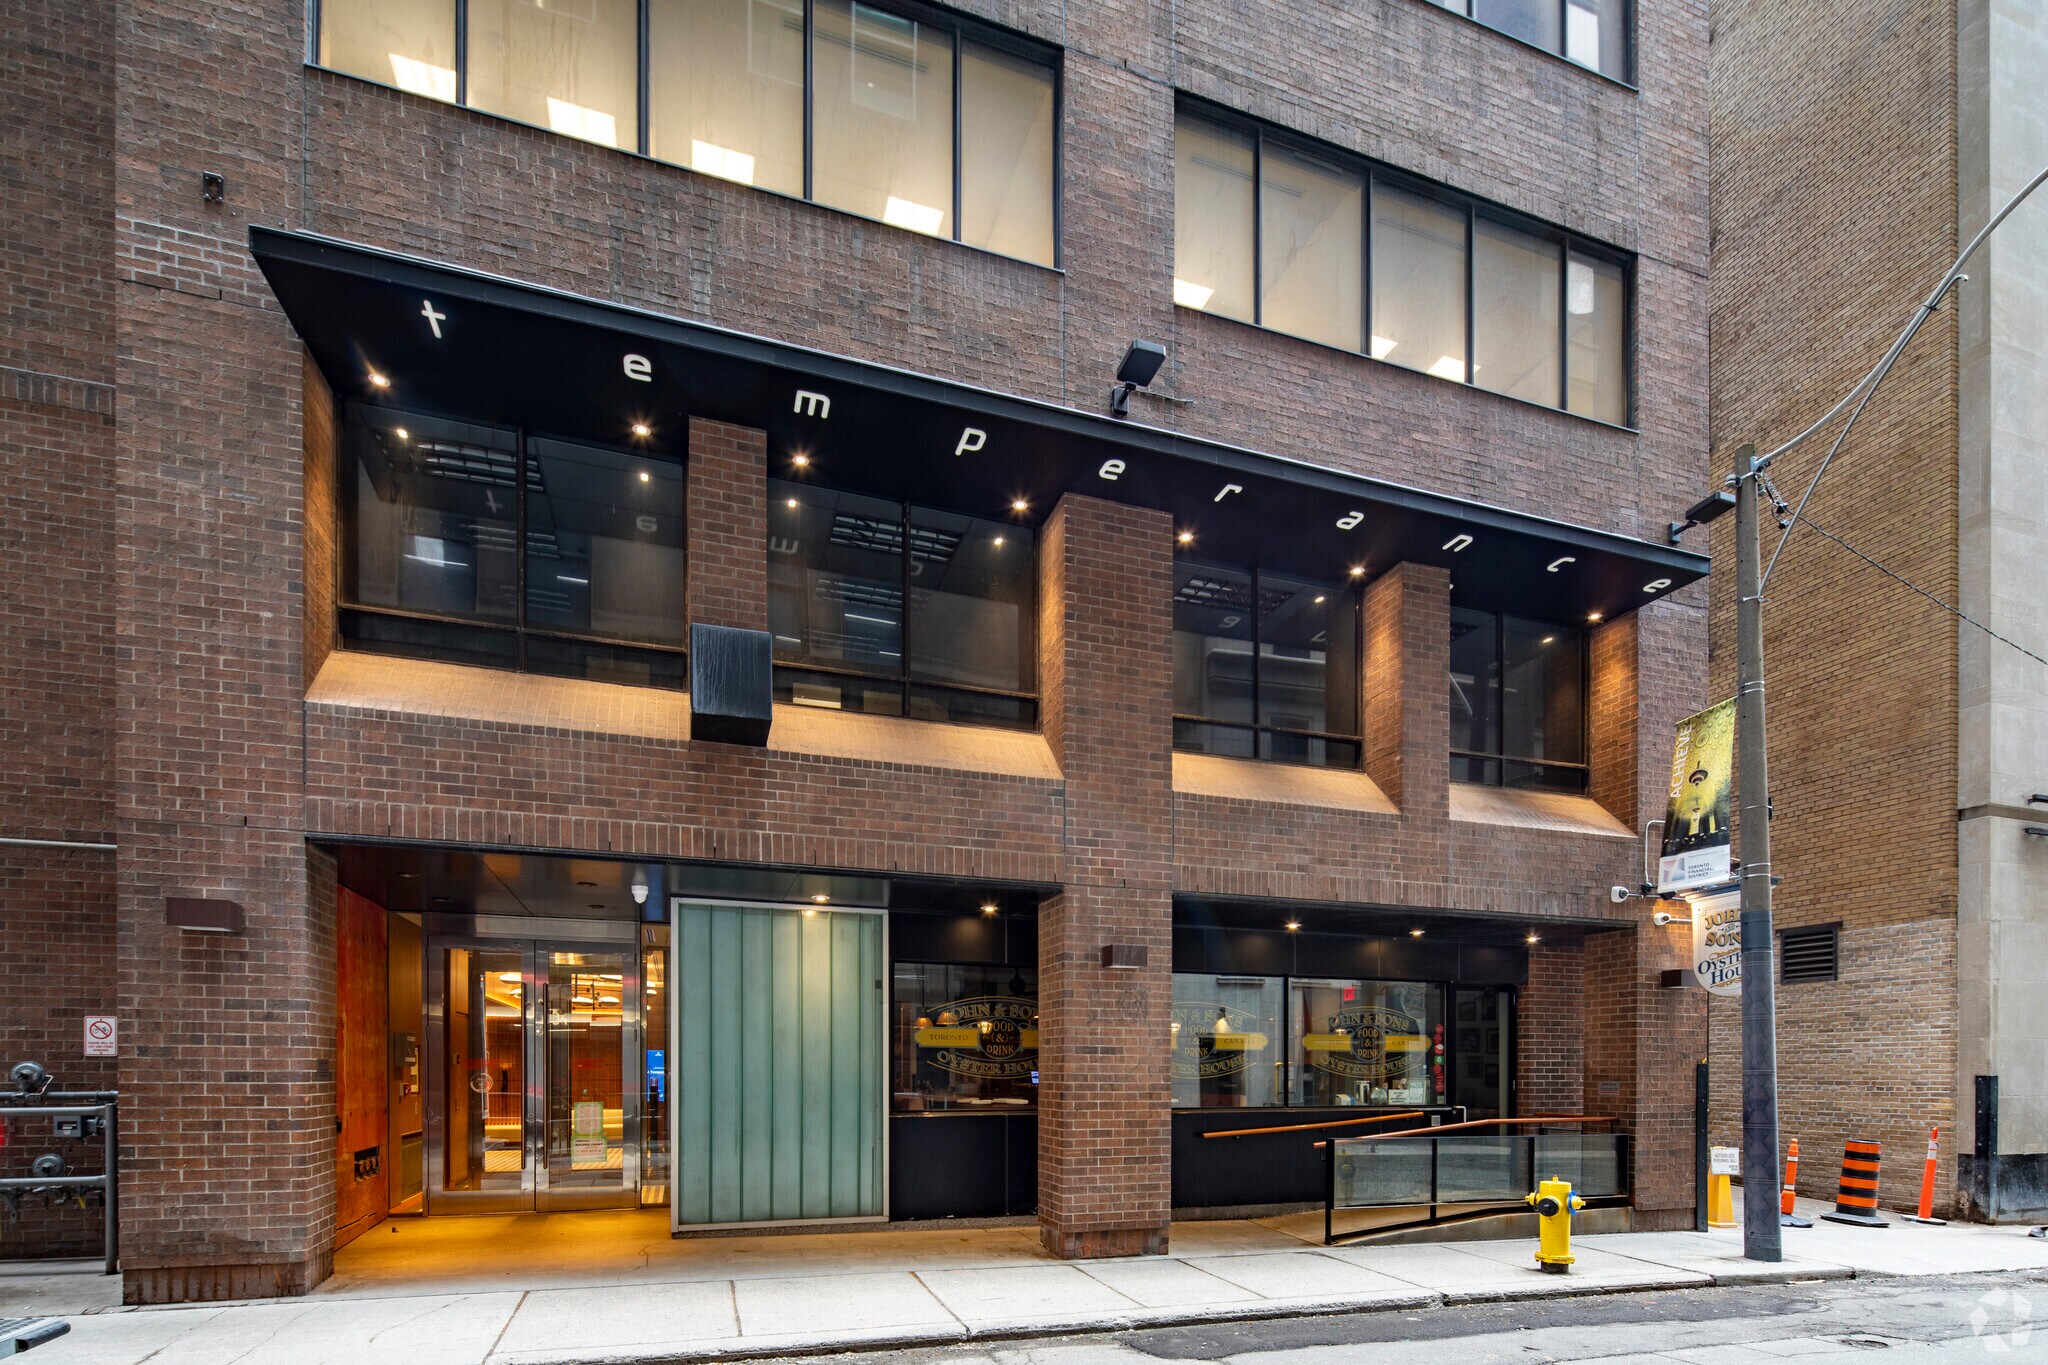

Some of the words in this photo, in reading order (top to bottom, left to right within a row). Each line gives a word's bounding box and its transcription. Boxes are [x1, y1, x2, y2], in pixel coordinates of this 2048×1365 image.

[1670, 724, 1693, 798] ACHIEVE
[1688, 862, 1710, 870] TORONTO
[1688, 866, 1712, 874] FINANCIAL
[1705, 908, 1741, 930] JOH
[1705, 930, 1741, 947] SON
[1698, 953, 1741, 974] OYSTE
[1710, 966, 1741, 984] HOU
[946, 1003, 991, 1022] OHN
[1375, 1012, 1410, 1031] SONS
[1184, 1025, 1208, 1035] FOOD
[1357, 1027, 1379, 1038] FOOD
[1223, 1037, 1255, 1045] CANADA
[986, 1045, 1014, 1056] DRINK
[1184, 1047, 1208, 1058] DRINK
[1357, 1048, 1379, 1059] DRINK
[936, 1050, 1001, 1074] OYSTER
[1004, 1059, 1038, 1074] HOU
